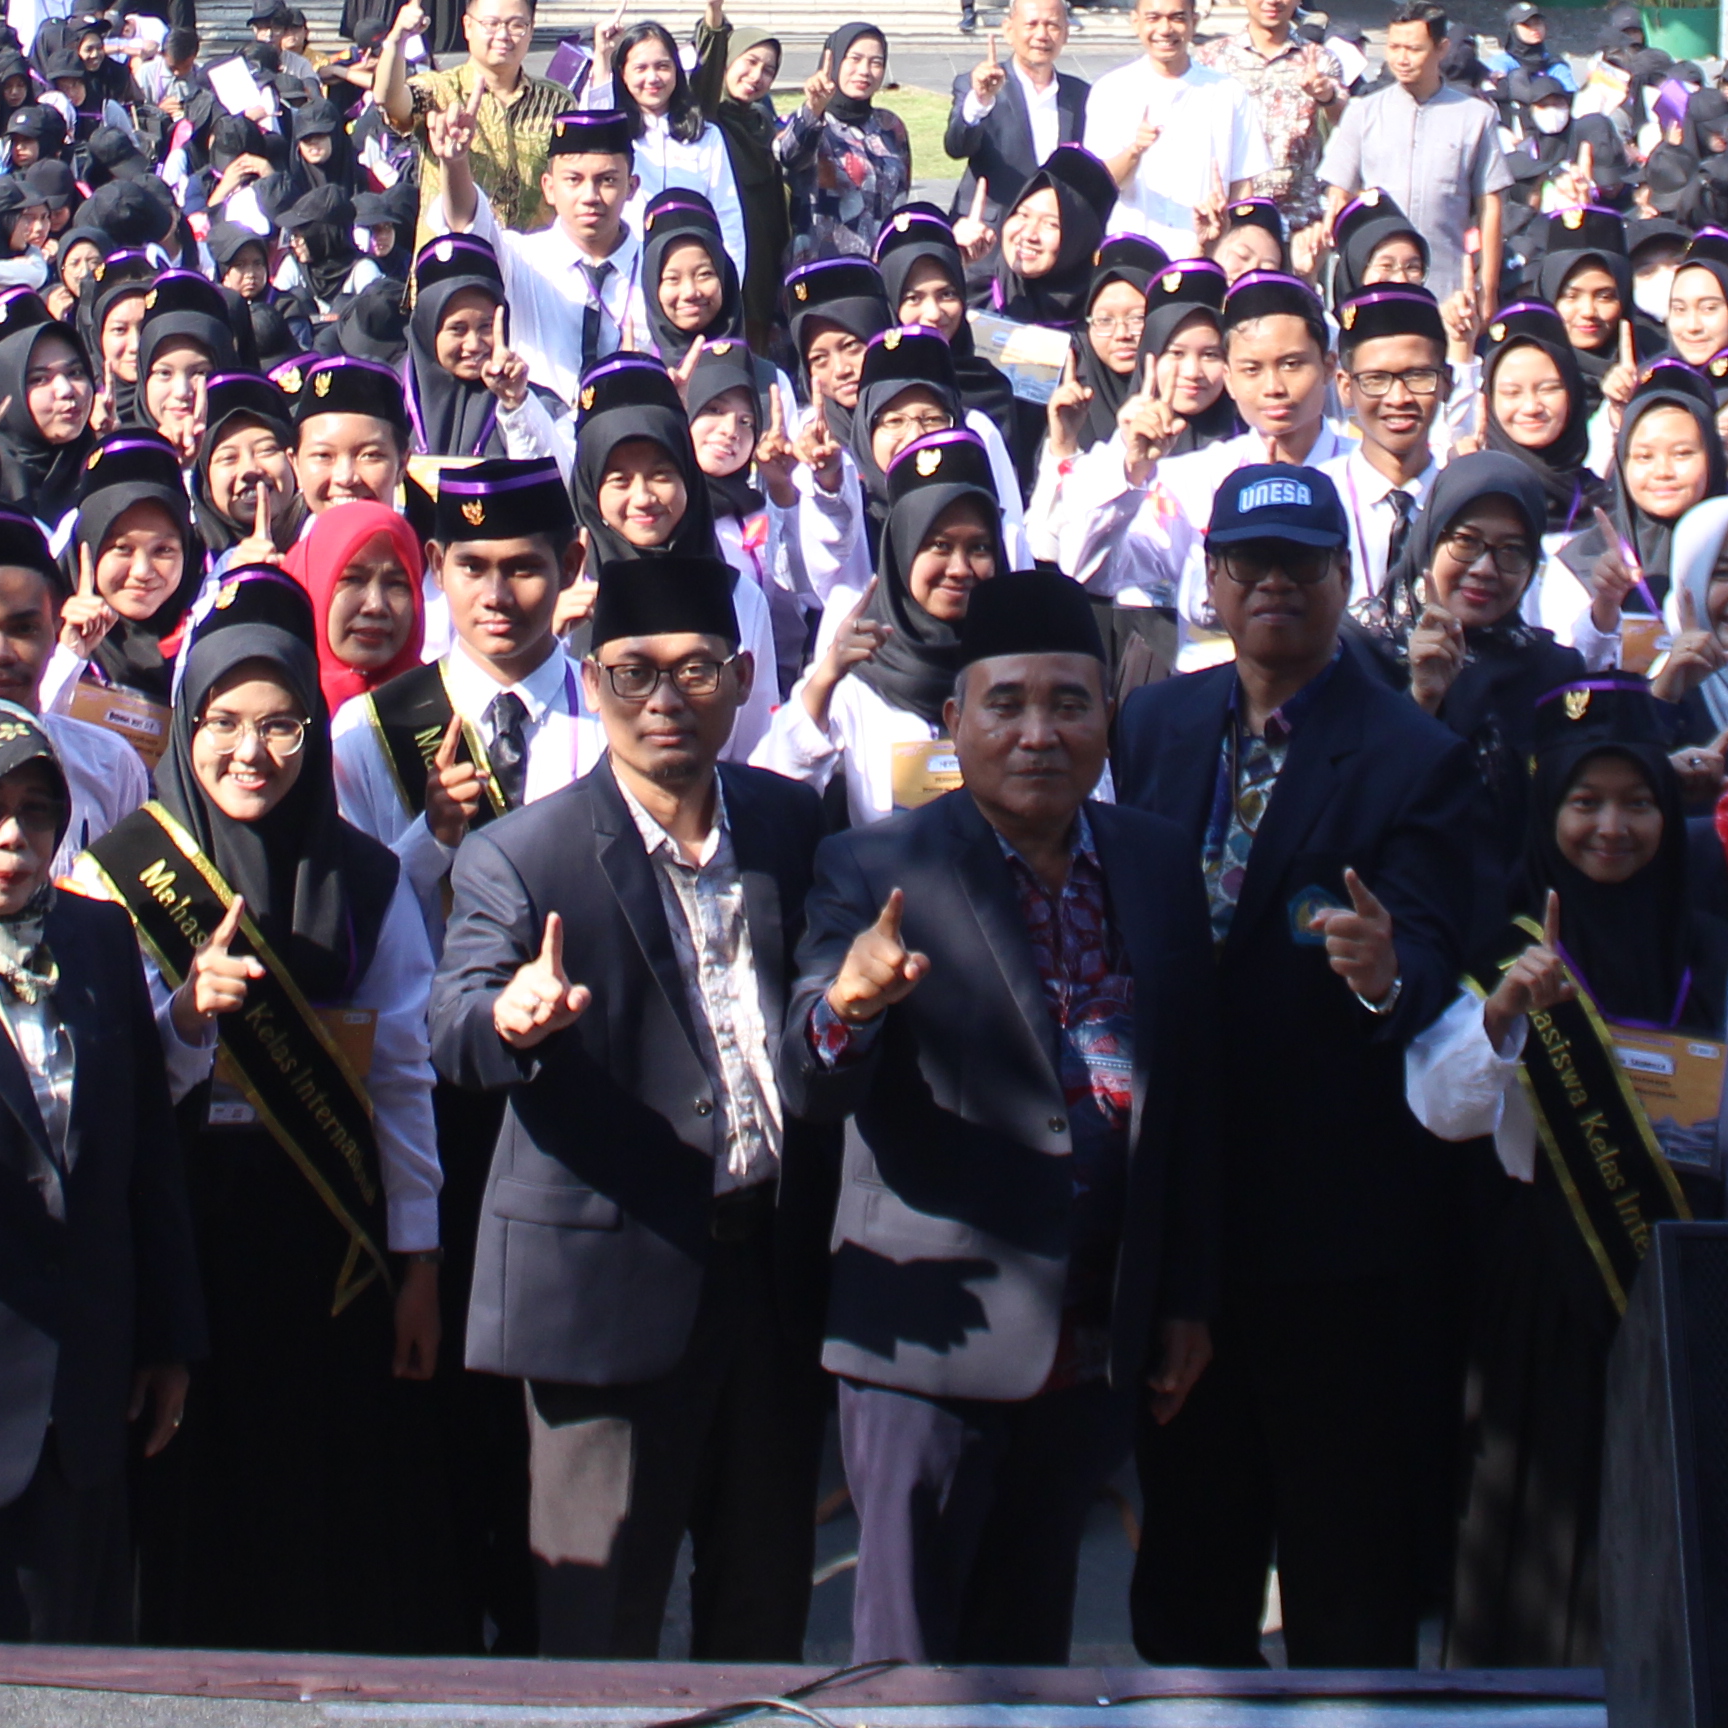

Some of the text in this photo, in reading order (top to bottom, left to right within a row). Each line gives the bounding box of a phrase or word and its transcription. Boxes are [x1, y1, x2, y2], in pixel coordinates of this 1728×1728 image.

[1238, 482, 1312, 513] UNESA
[244, 1001, 298, 1076] Kelas
[1579, 1111, 1628, 1193] Kelas
